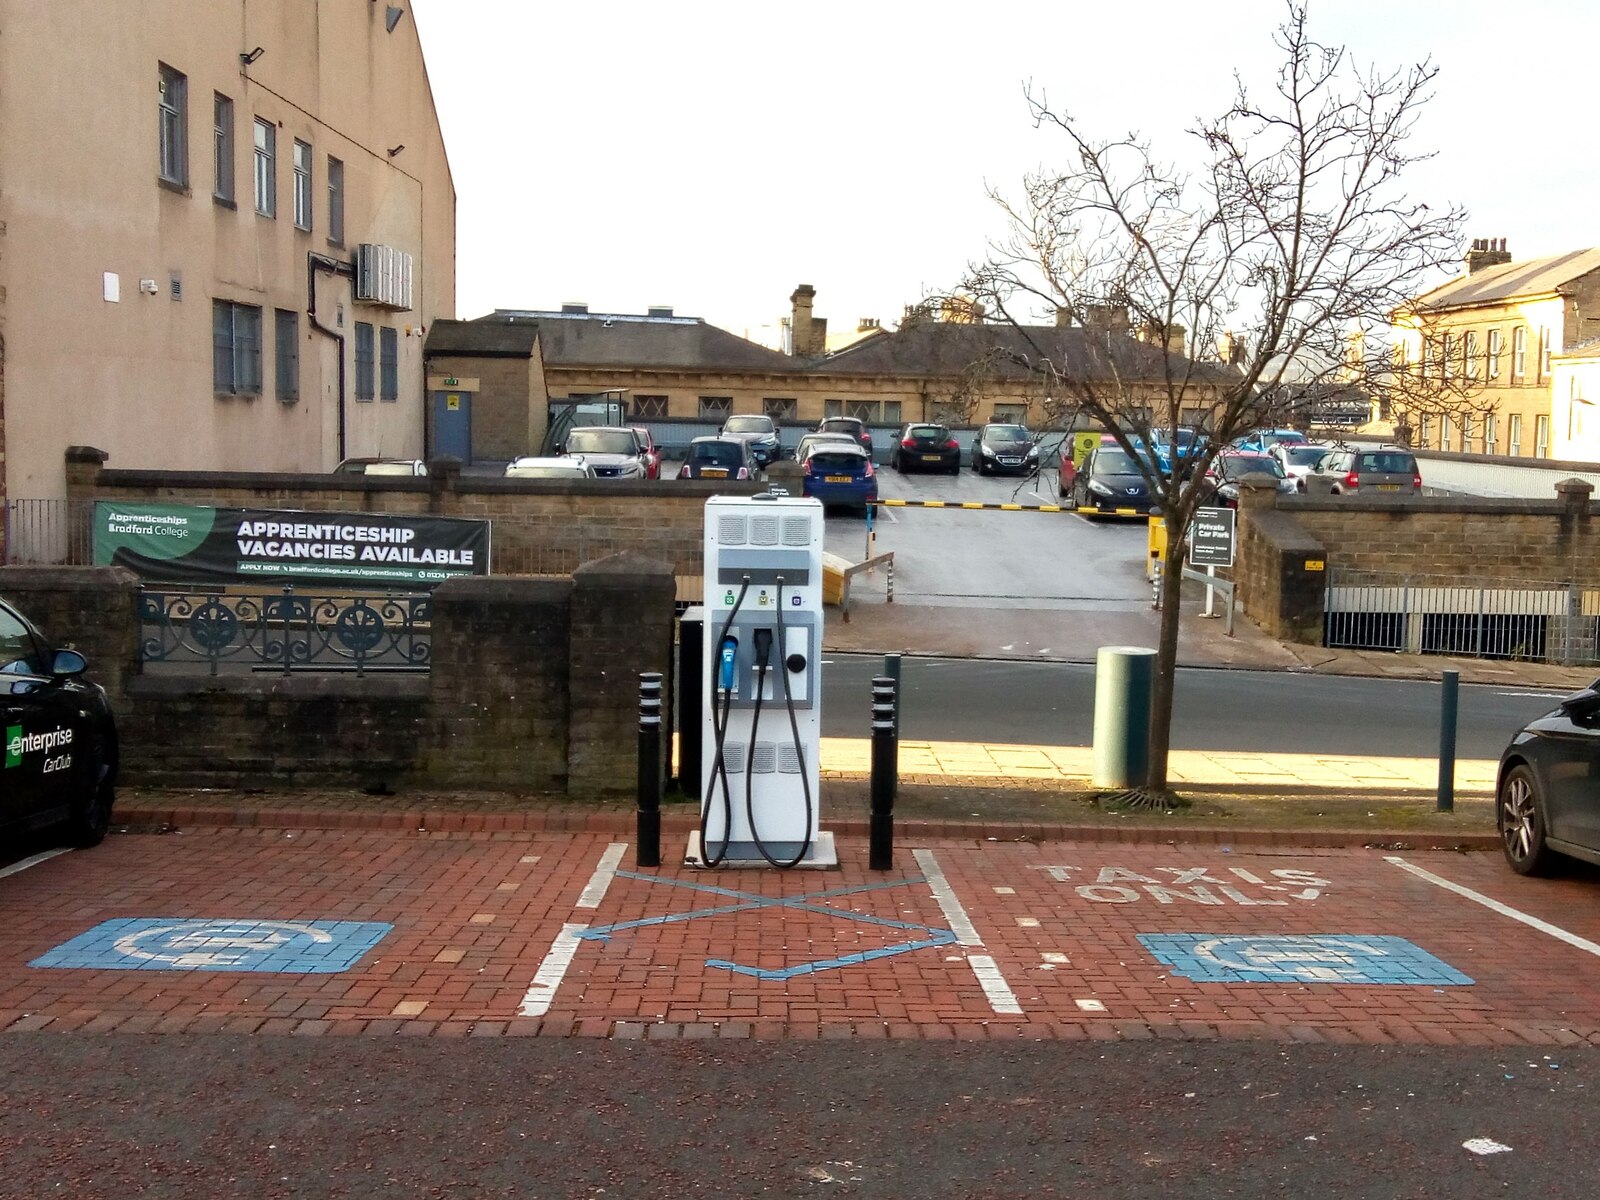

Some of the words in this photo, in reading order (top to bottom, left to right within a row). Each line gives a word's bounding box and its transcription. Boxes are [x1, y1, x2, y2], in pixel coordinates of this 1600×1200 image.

[108, 512, 188, 525] Apprenticeships
[1198, 523, 1226, 532] Private
[108, 524, 153, 535] Bradford
[154, 525, 189, 539] College
[237, 520, 415, 544] APPRENTICESHIP
[1198, 530, 1212, 538] Car
[1212, 531, 1230, 539] Park
[237, 539, 356, 560] VACANCIES
[360, 545, 474, 565] AVAILABLE
[240, 563, 262, 571] APPLY
[7, 725, 73, 755] enterprise
[1025, 865, 1332, 887] TAXIS
[1074, 884, 1321, 906] ONLY
